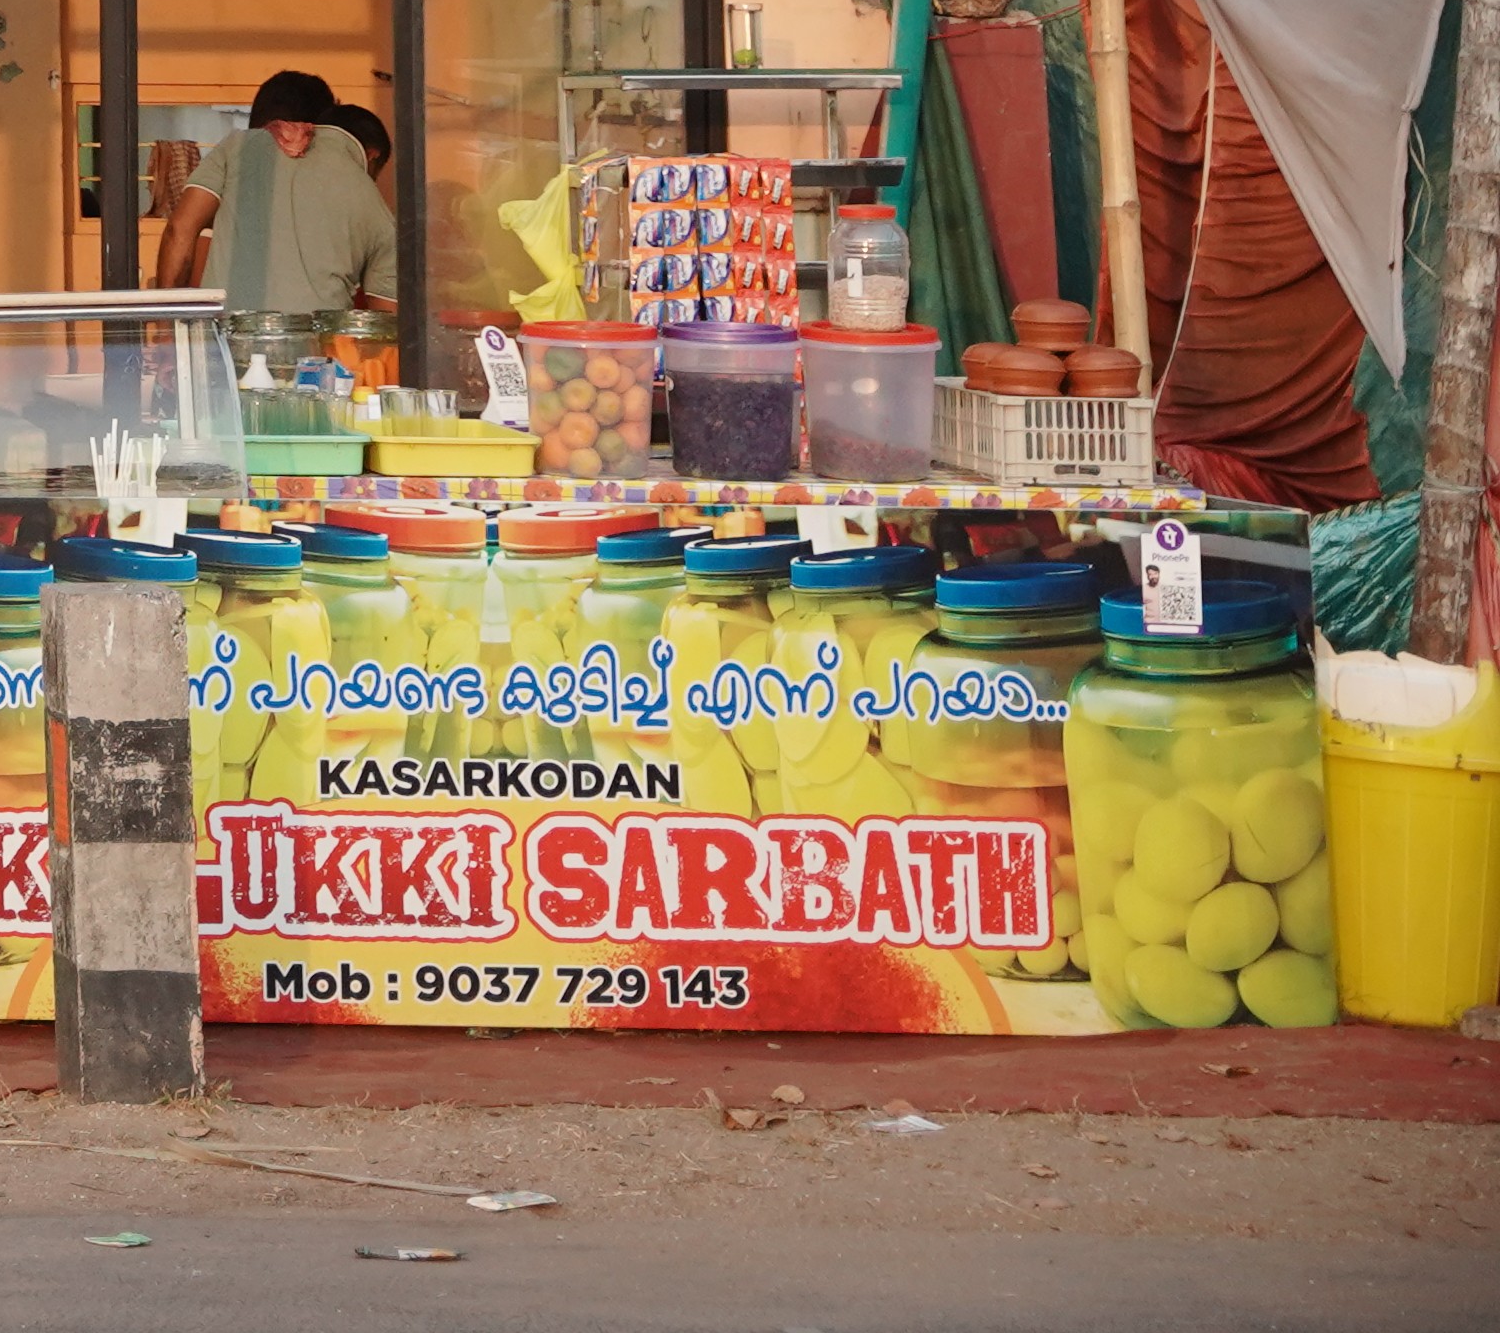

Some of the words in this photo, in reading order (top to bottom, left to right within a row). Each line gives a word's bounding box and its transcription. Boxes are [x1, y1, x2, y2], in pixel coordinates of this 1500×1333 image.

[1152, 552, 1190, 563] PhonePe
[319, 759, 681, 800] KASARKODAN
[537, 826, 1037, 935] SARBATH
[263, 964, 371, 1002] Mob
[415, 965, 541, 1004] 9037
[556, 966, 647, 1005] 729
[663, 967, 748, 1006] 143
